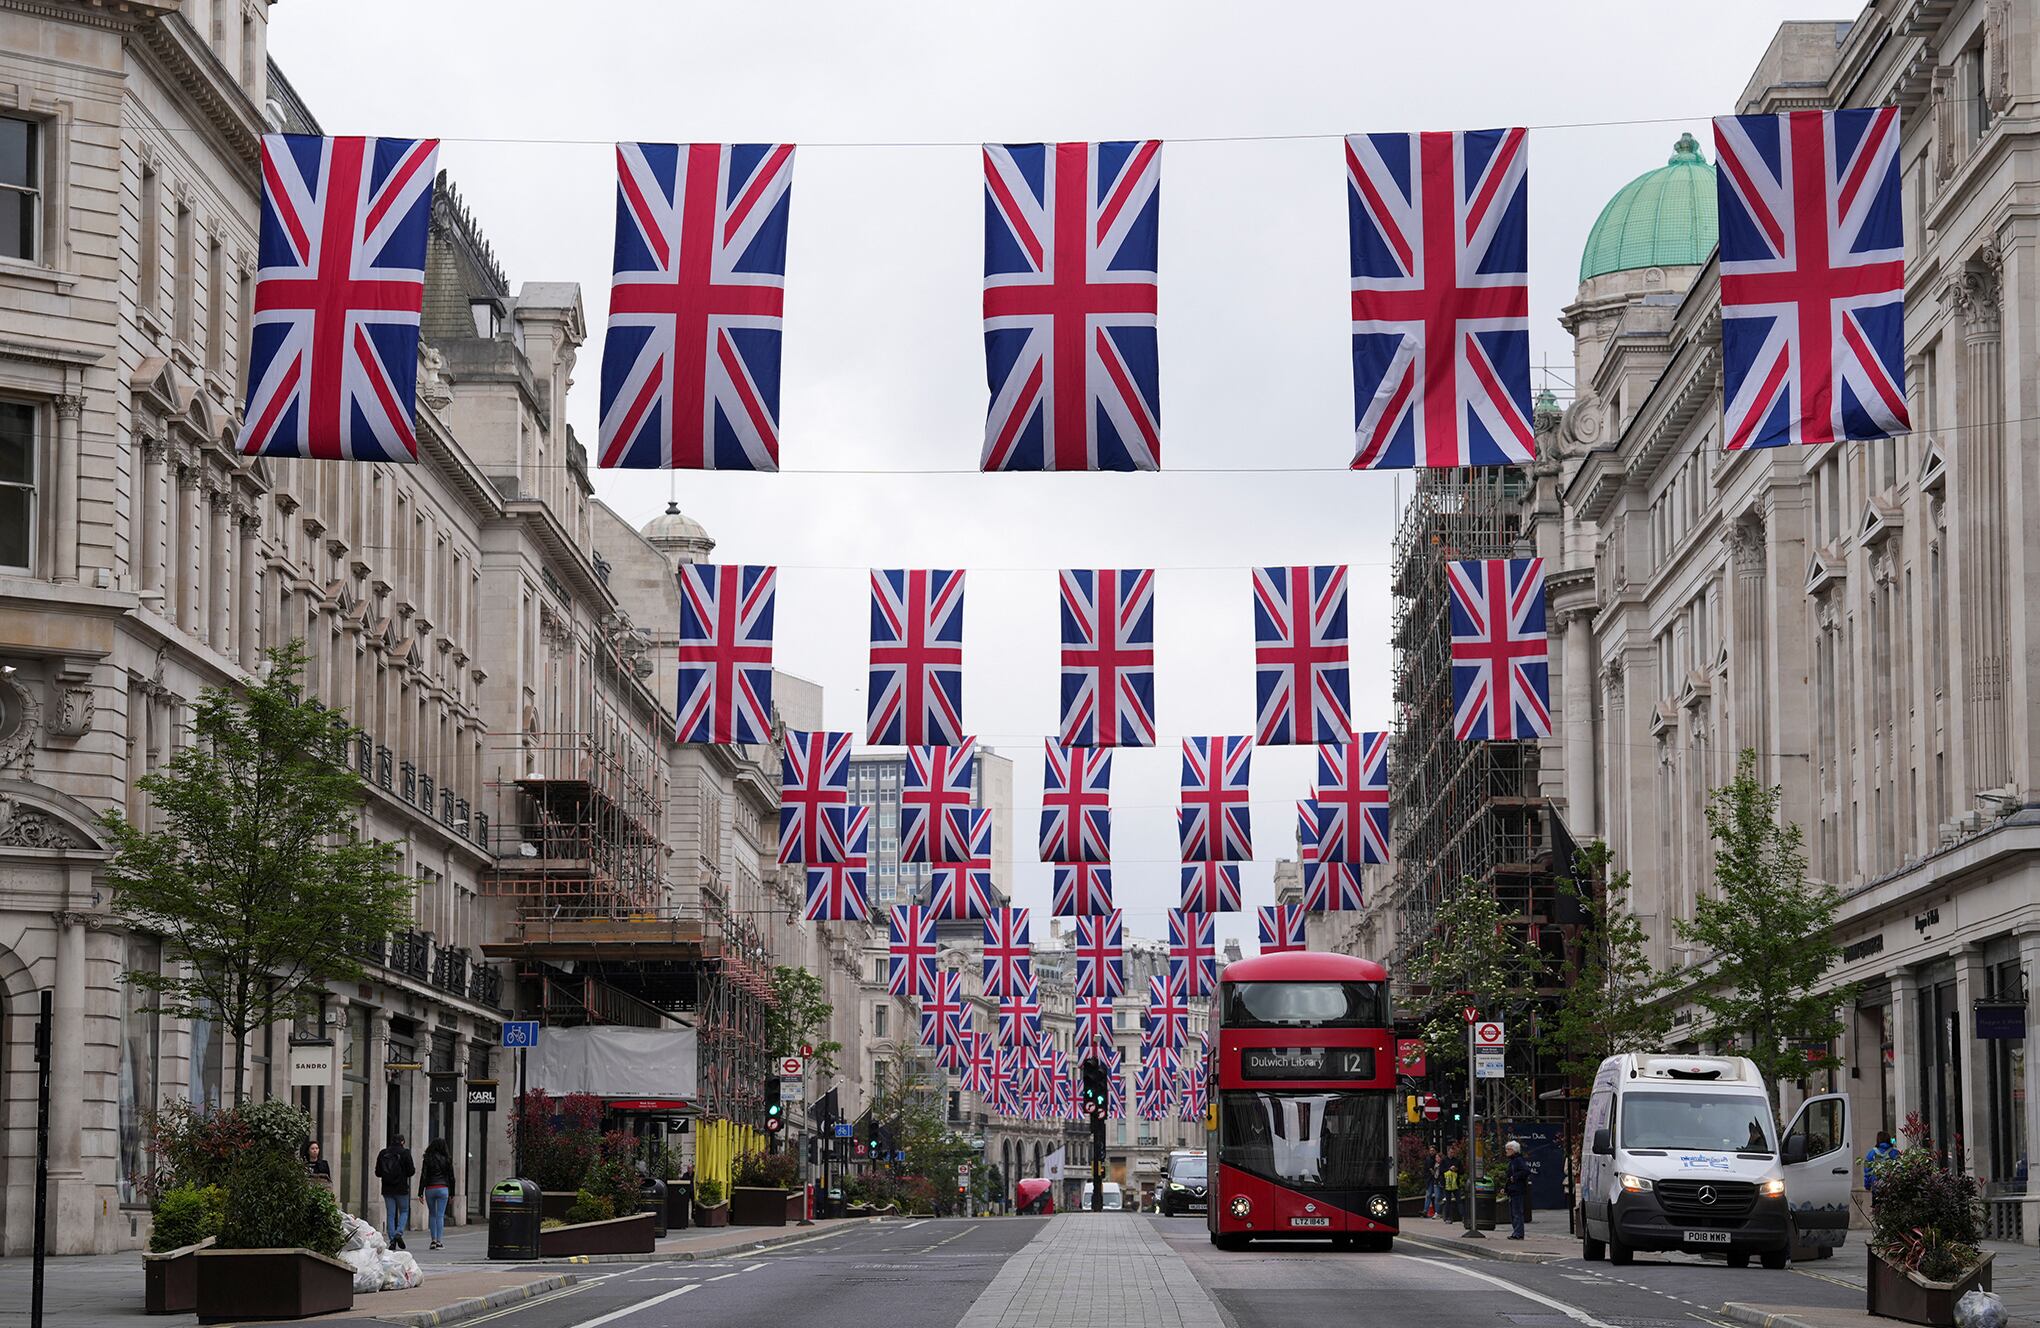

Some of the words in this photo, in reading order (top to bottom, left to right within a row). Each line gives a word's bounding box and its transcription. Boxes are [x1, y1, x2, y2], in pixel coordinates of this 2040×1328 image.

[1465, 1009, 1476, 1020] V
[803, 1046, 809, 1055] L
[1251, 1056, 1288, 1067] Dulwich
[1291, 1057, 1324, 1069] Library
[1344, 1053, 1361, 1072] 12
[468, 1091, 495, 1100] KARL
